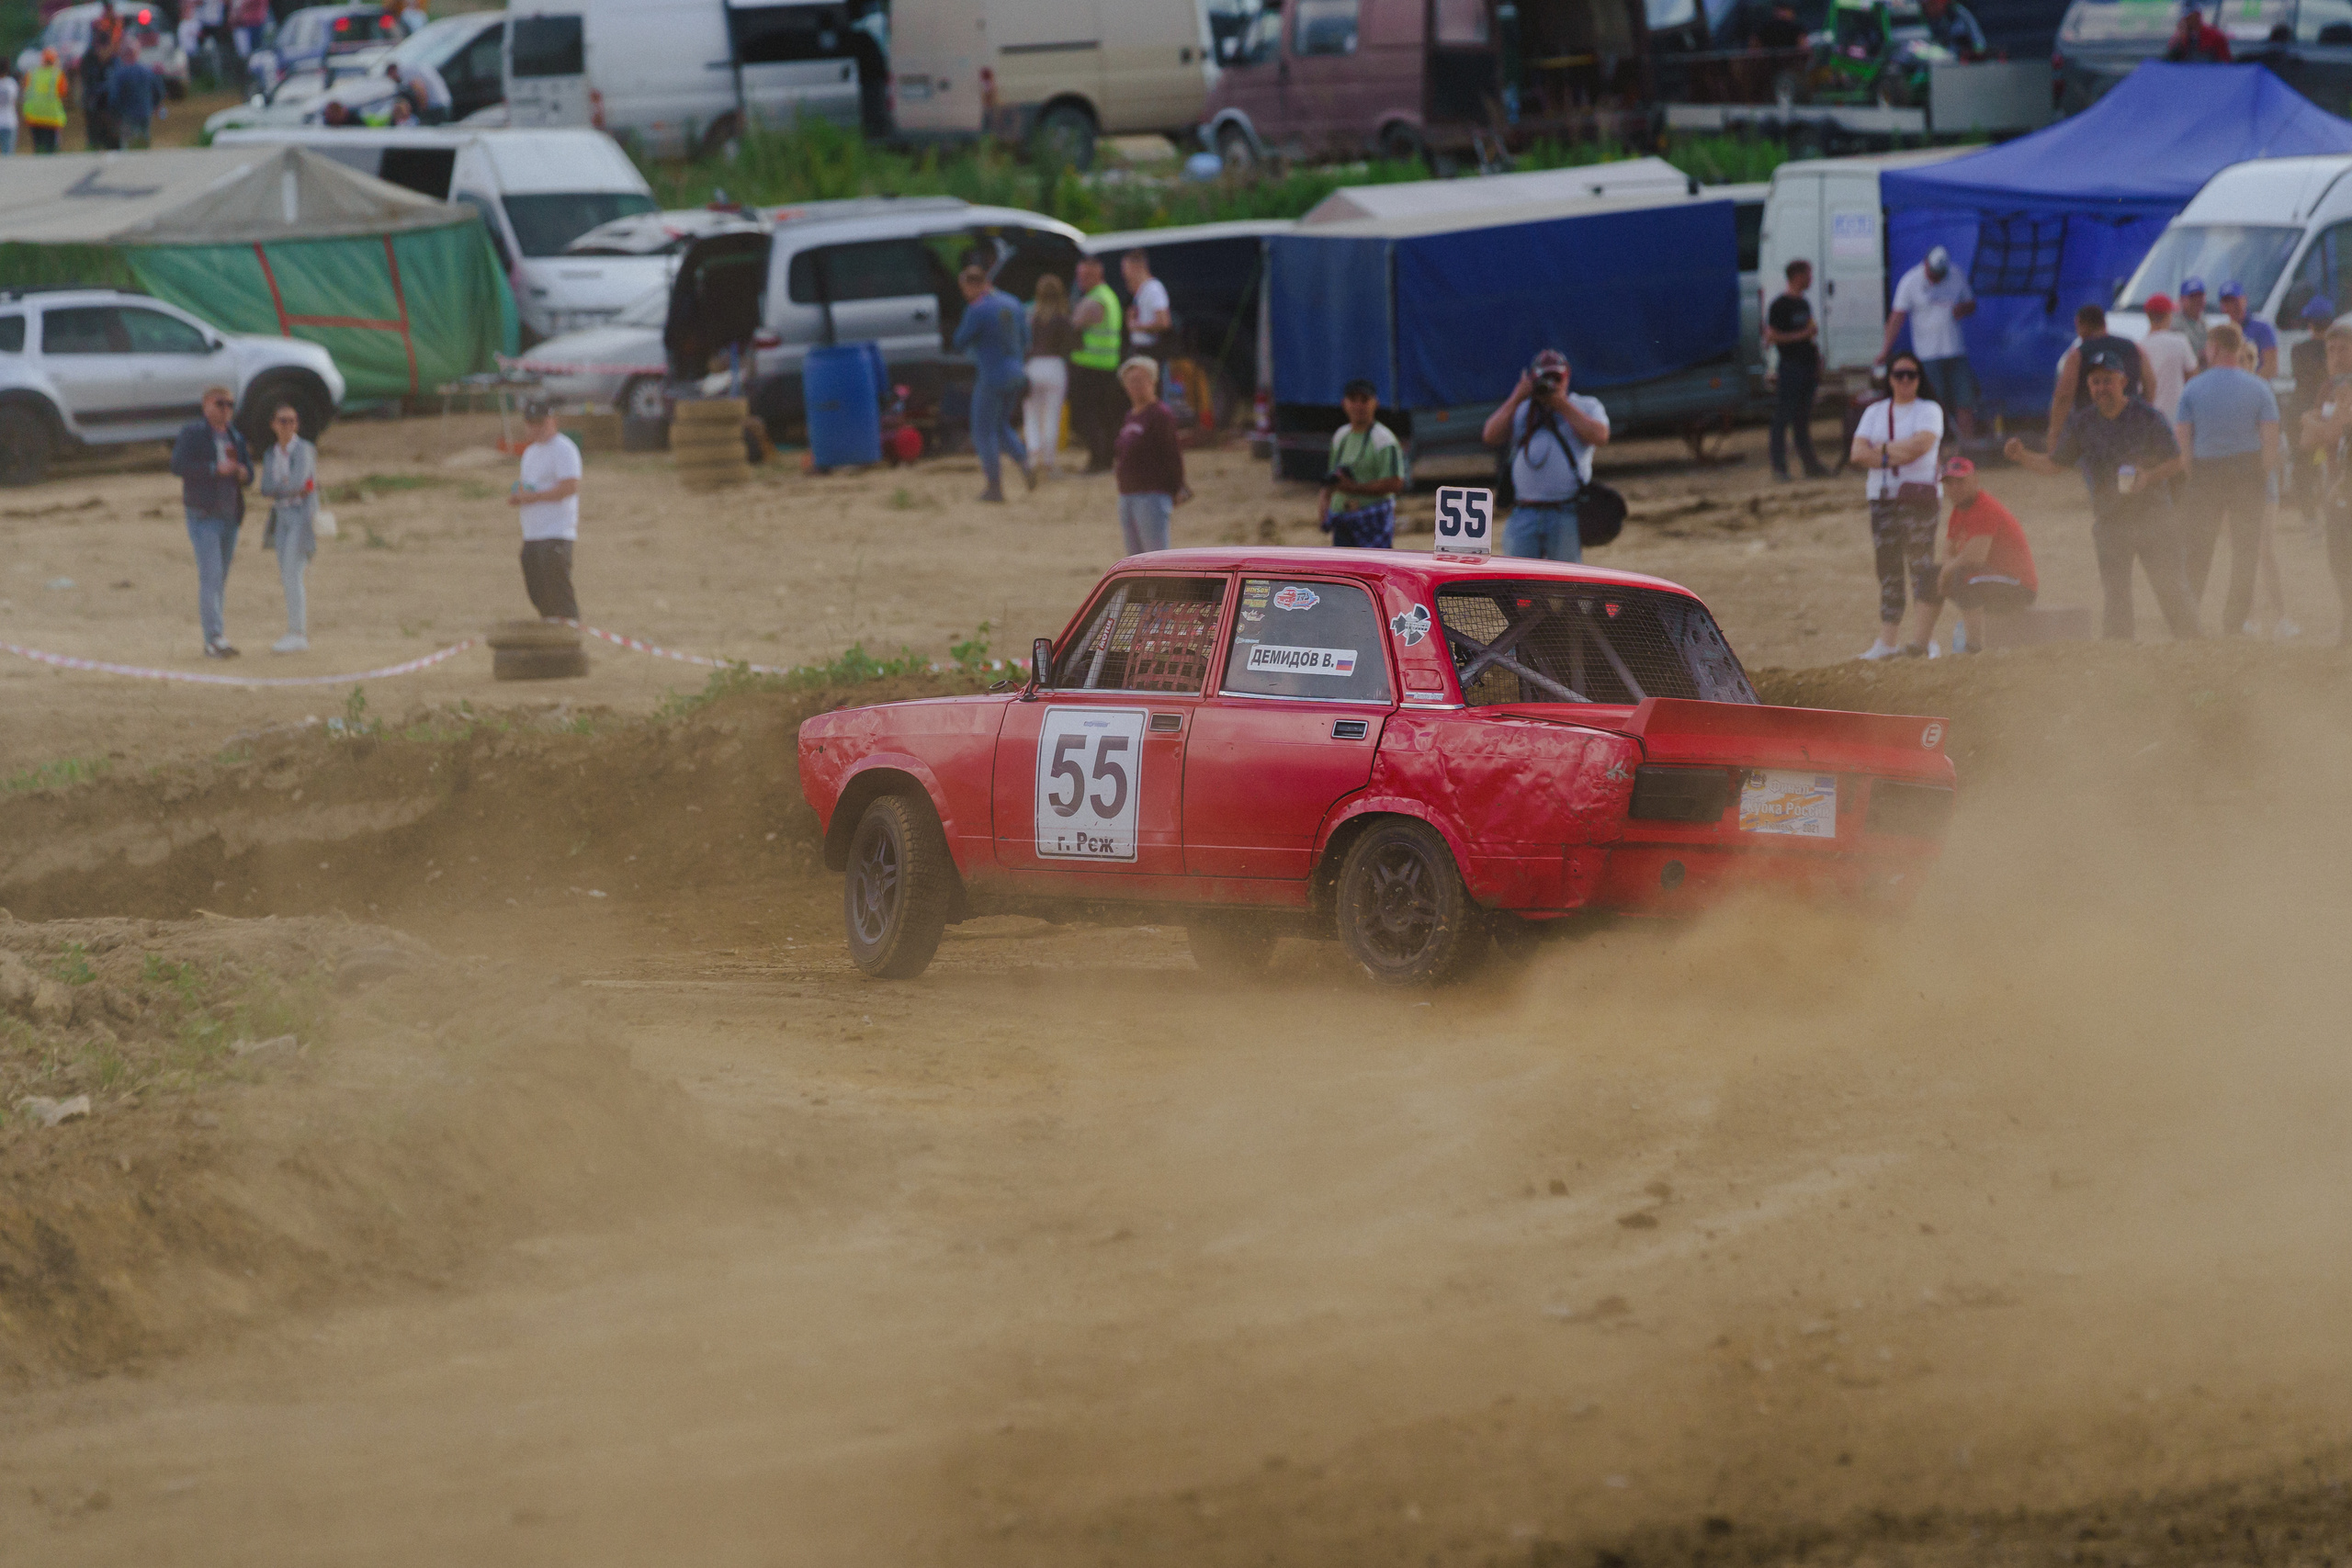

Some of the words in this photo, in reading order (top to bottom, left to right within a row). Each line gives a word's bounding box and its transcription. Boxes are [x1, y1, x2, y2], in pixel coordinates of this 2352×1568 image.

[1439, 490, 1487, 538] 55
[1099, 619, 1113, 649] MOTUL
[1250, 649, 1318, 668] ДЕМИДОВ
[1322, 654, 1334, 668] В.
[1925, 726, 1940, 744] E
[1048, 734, 1129, 819] 55
[1770, 780, 1810, 795] Финал
[1785, 802, 1830, 818] России
[1803, 823, 1820, 833] 2021
[1057, 836, 1070, 851] г.
[1077, 832, 1114, 852] Реж
